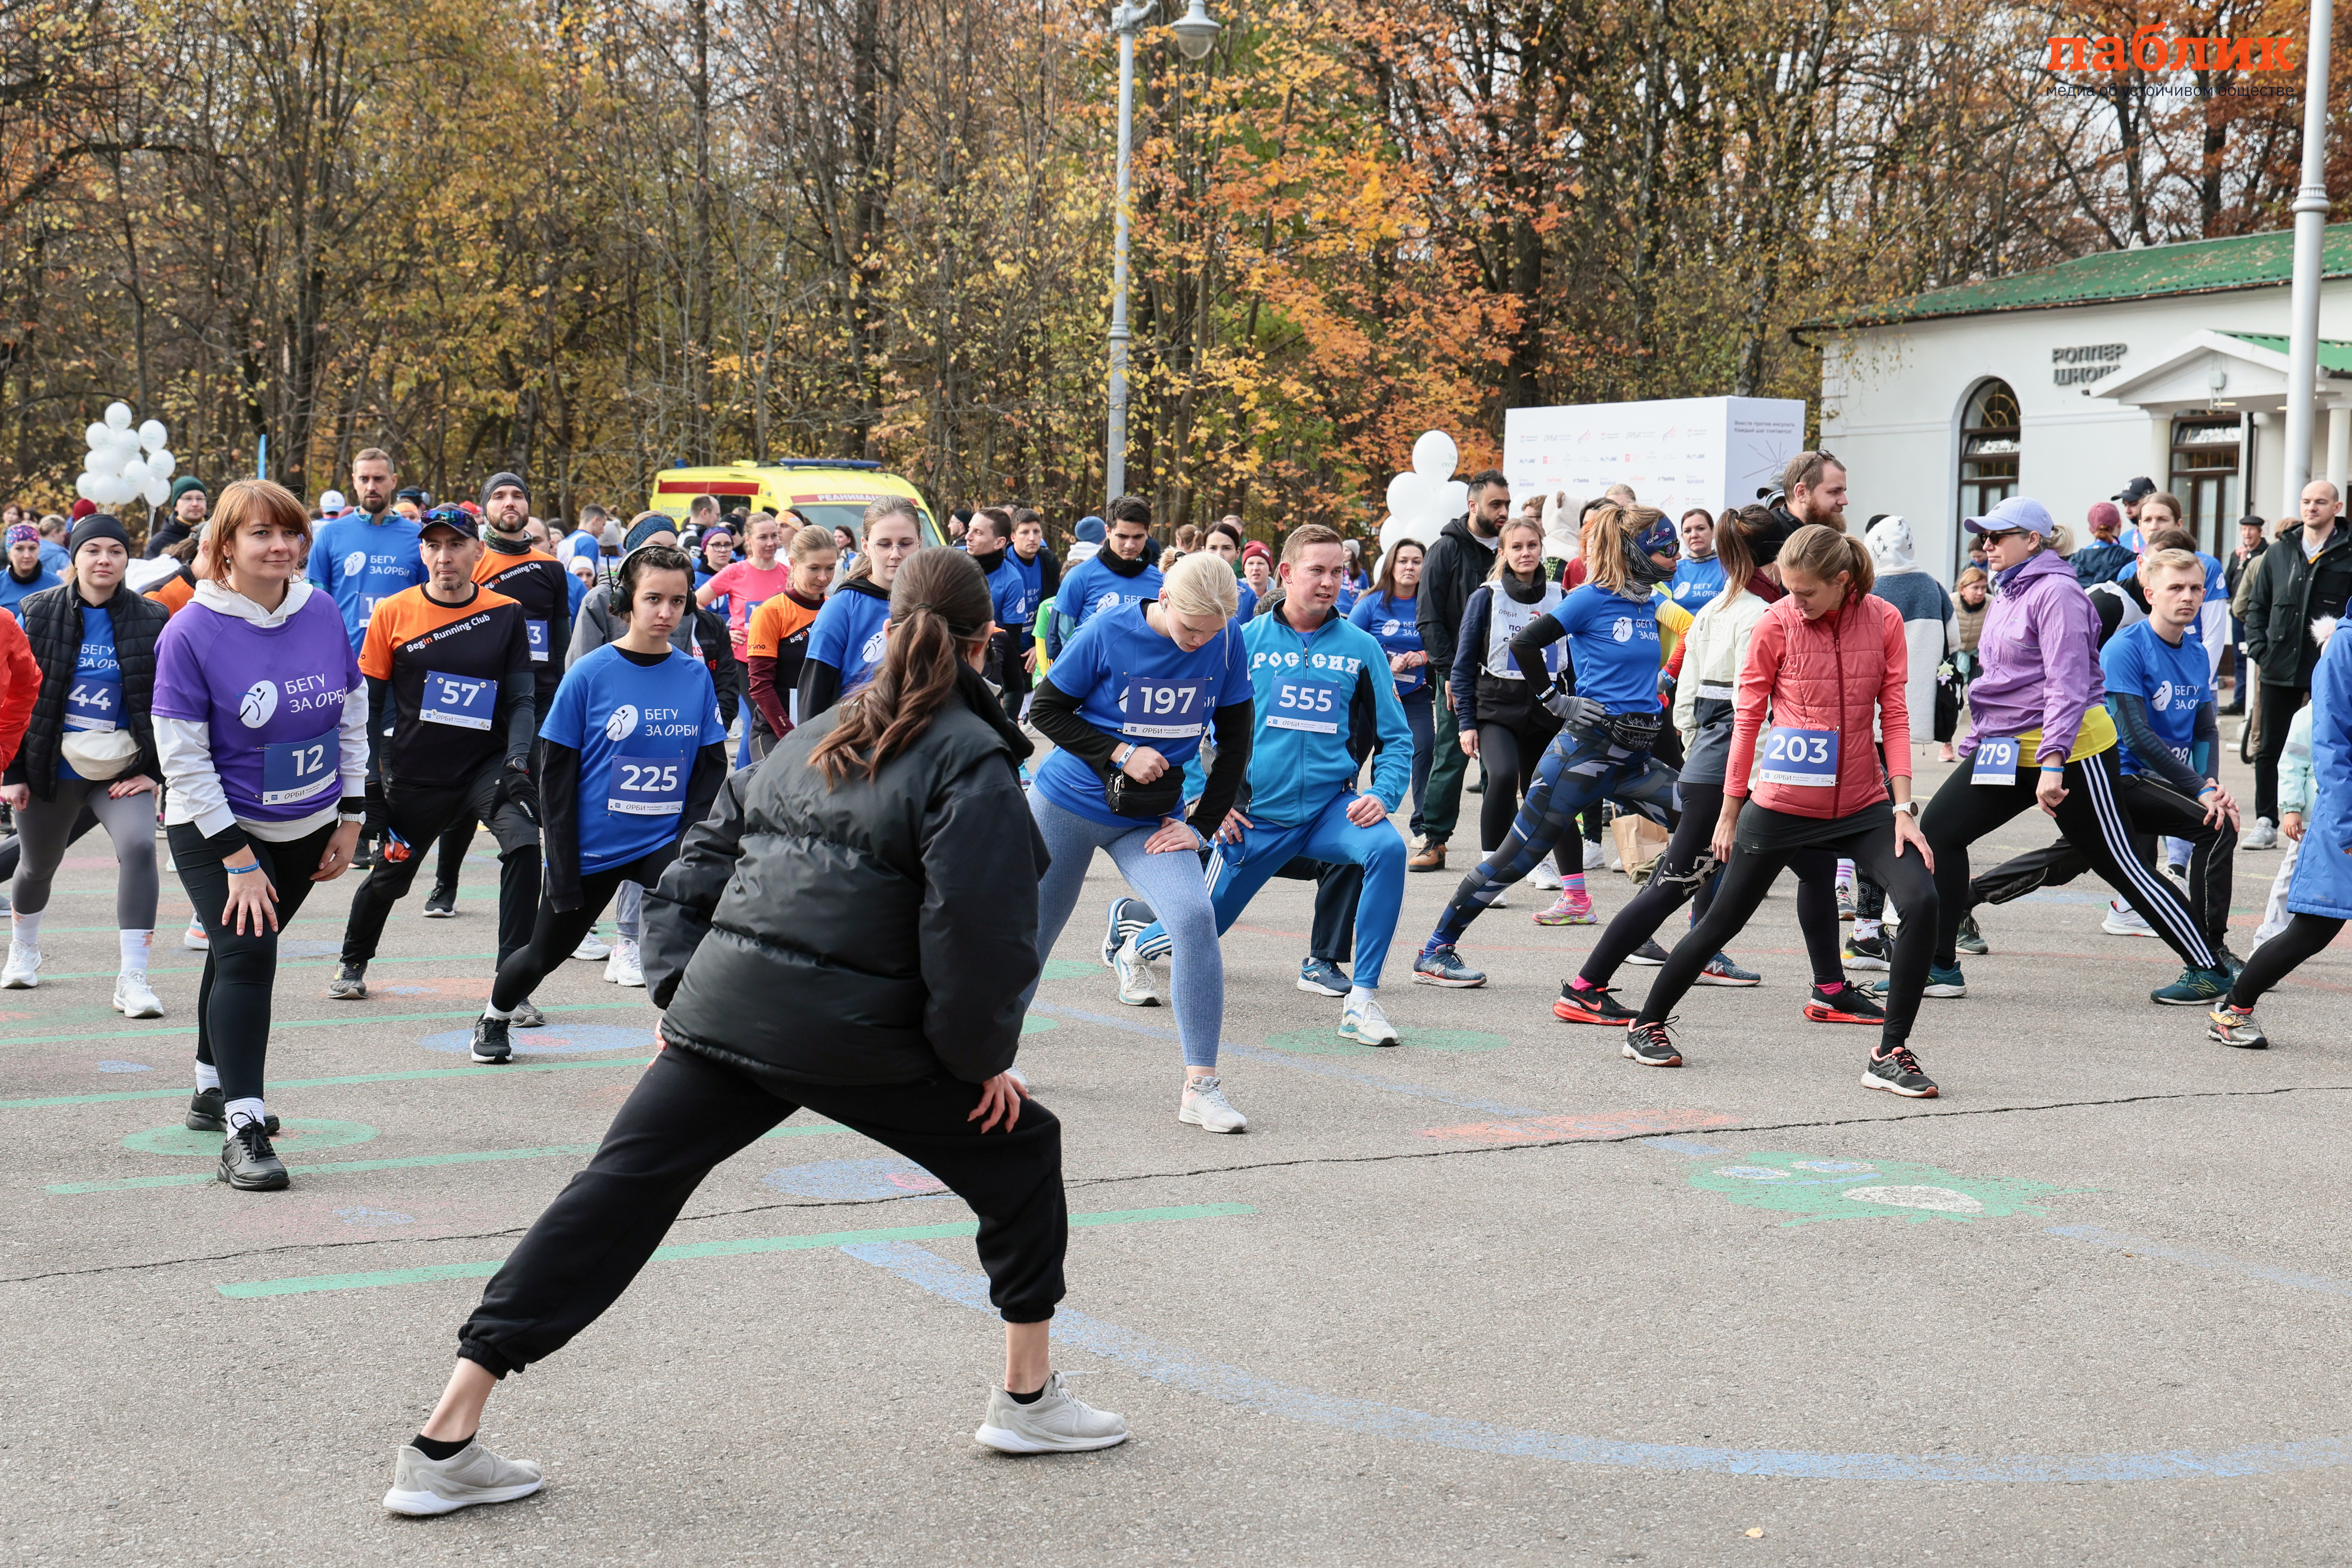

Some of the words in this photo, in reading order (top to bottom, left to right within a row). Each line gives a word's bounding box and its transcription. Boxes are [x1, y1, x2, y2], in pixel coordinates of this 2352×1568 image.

[370, 555, 396, 564] БЕГУ
[369, 566, 382, 574] ЗА
[383, 566, 410, 577] ОРБИ
[482, 577, 500, 589] egIn
[500, 564, 530, 581] Running
[1499, 609, 1517, 617] ОРБИ
[433, 622, 472, 641] Running
[470, 614, 490, 626] Club
[1636, 619, 1653, 628] БЕГУ
[1639, 631, 1649, 640] ЗА
[81, 644, 115, 656] БЕГУ
[78, 657, 95, 668] ЗА
[285, 673, 325, 694] БЕГУ
[2174, 685, 2200, 696] БЕГУ
[68, 684, 112, 710] 44
[289, 697, 313, 713] ЗА
[315, 687, 348, 708] ОРБИ
[440, 680, 480, 707] 57
[1141, 687, 1197, 714] 197
[1278, 684, 1332, 712] 555
[2175, 699, 2187, 710] ЗА
[644, 708, 679, 720] БЕГУ
[645, 725, 662, 736] ЗА
[664, 724, 699, 736] ОРБИ
[1769, 734, 1828, 764] 203
[1977, 743, 2011, 765] 279
[292, 744, 324, 777] 12
[620, 764, 677, 792] 225
[284, 790, 305, 800] ОРБИ
